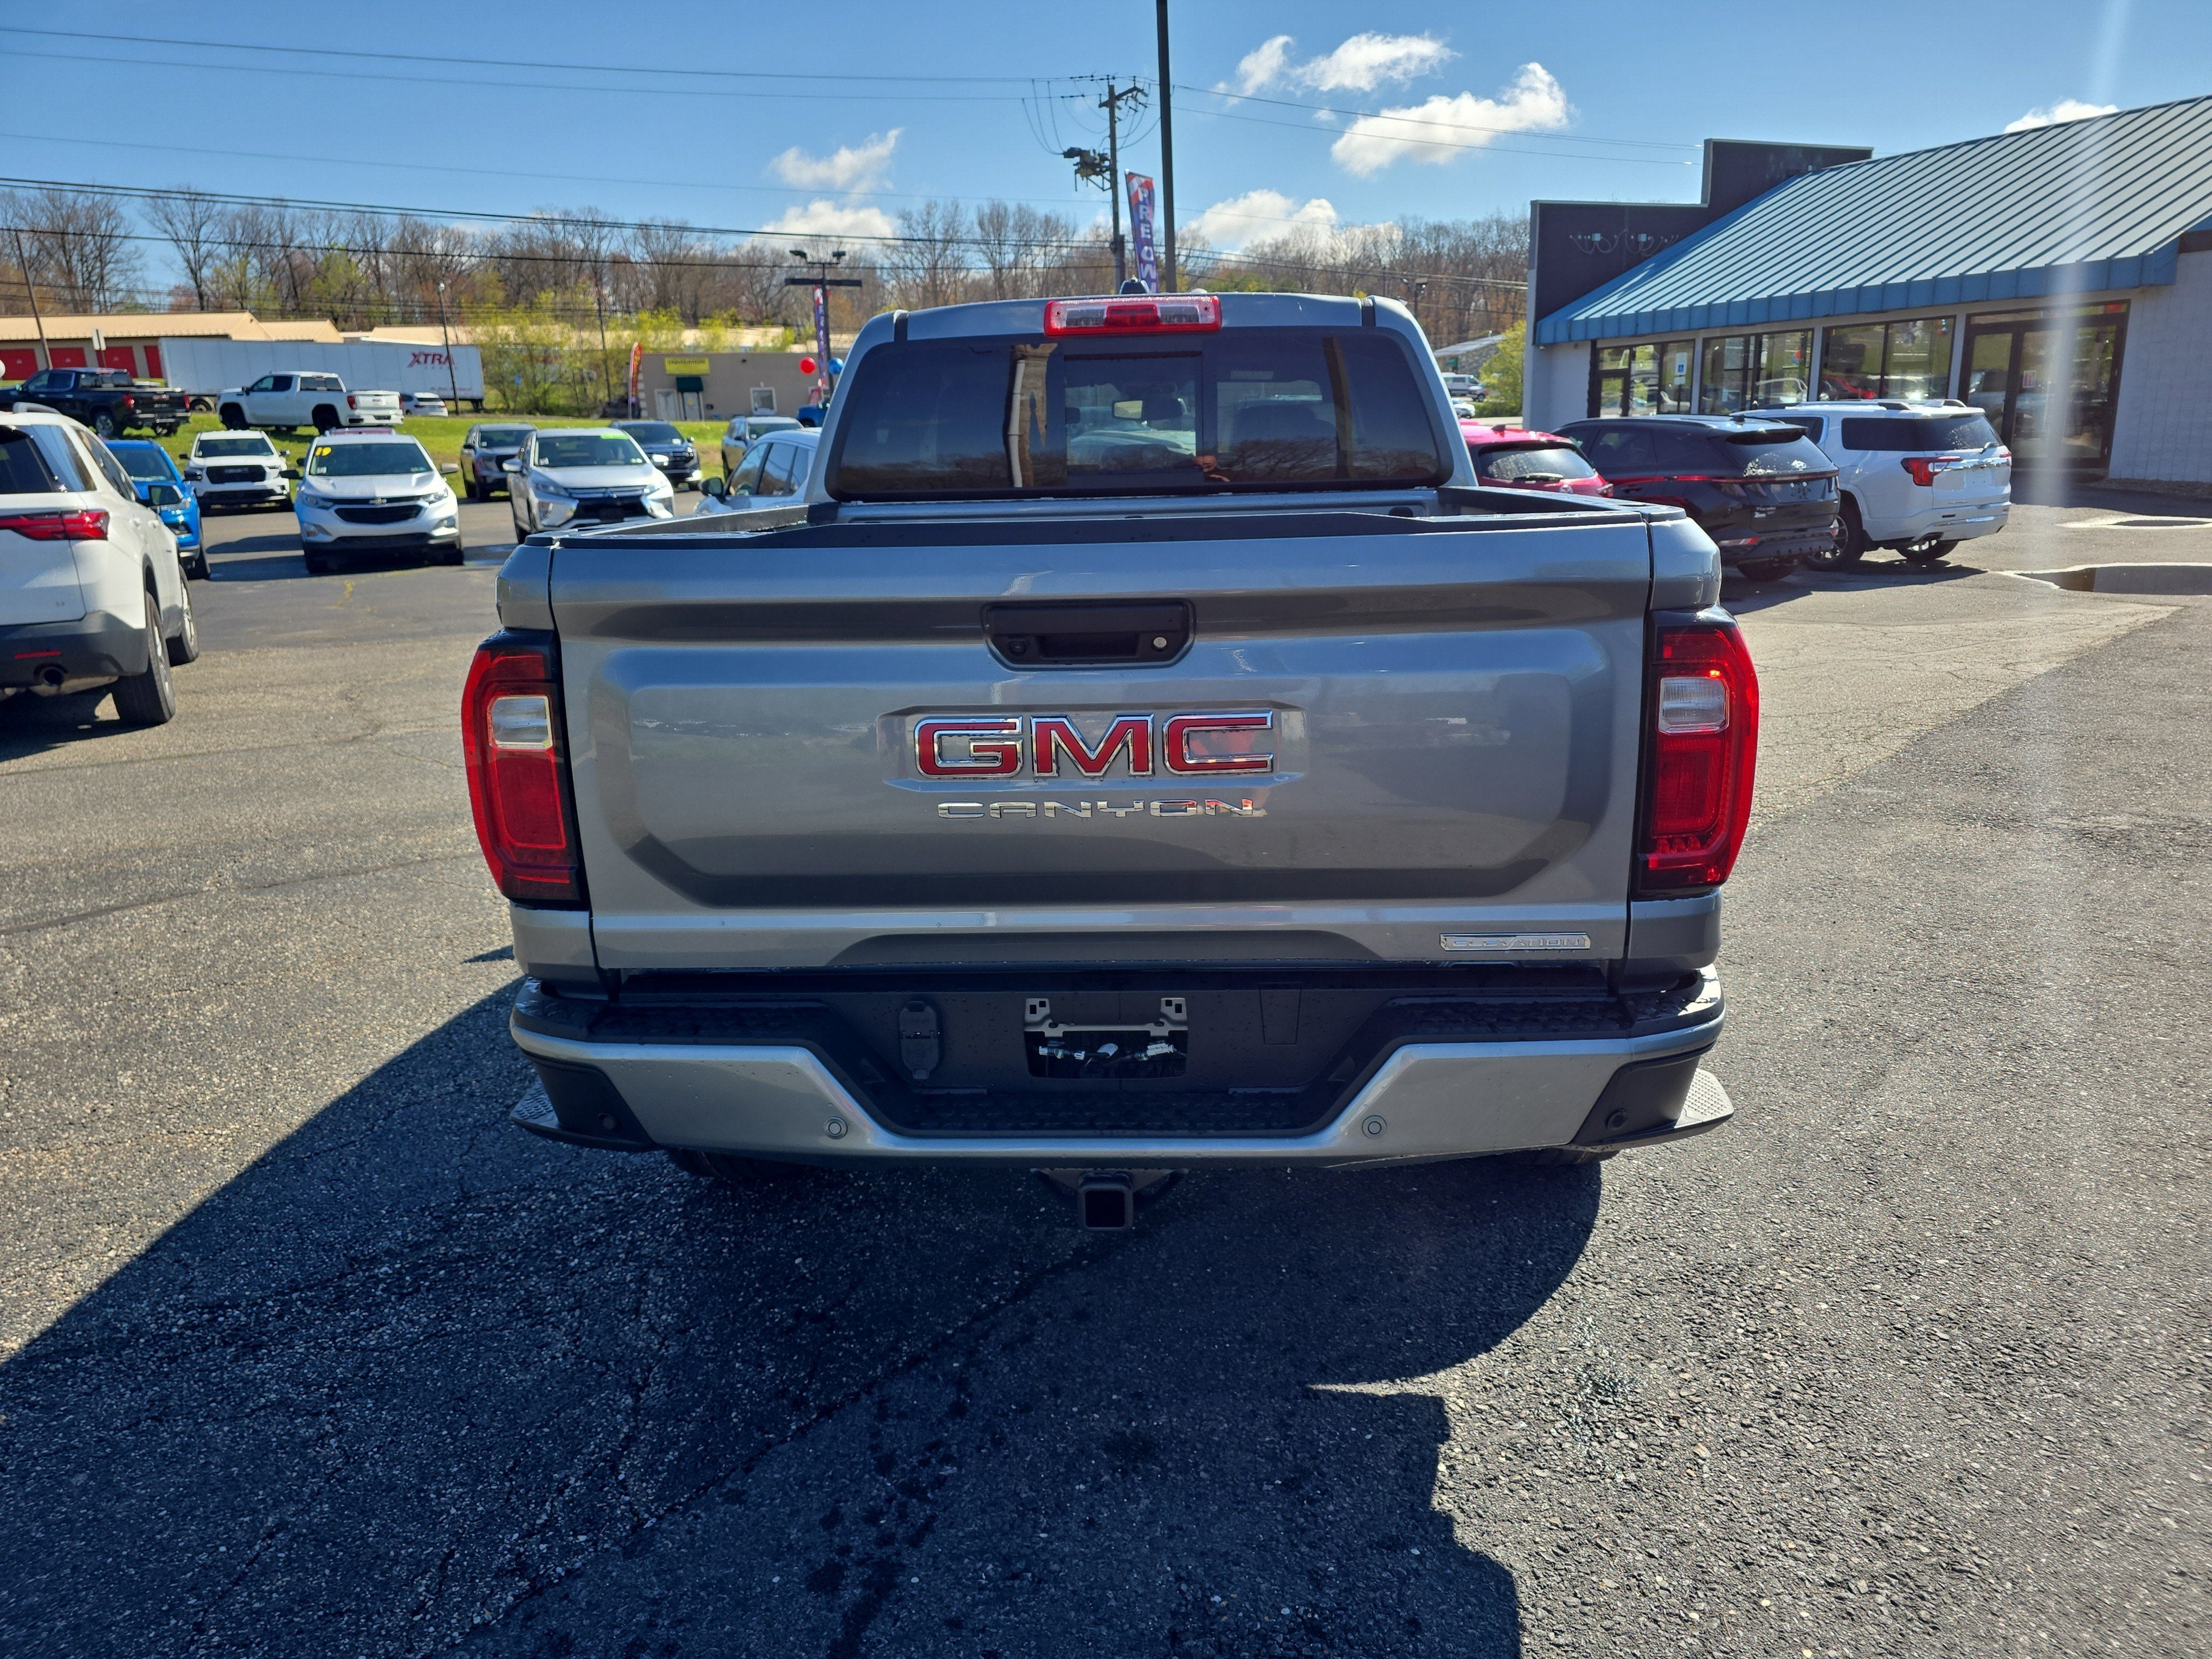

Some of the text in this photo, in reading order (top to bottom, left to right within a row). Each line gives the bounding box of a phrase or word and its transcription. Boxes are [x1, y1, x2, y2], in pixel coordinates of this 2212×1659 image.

[407, 351, 455, 368] XTRA
[914, 710, 1274, 777] GMC
[937, 799, 1254, 819] CANYON
[1452, 936, 1579, 948] ELEVATION
